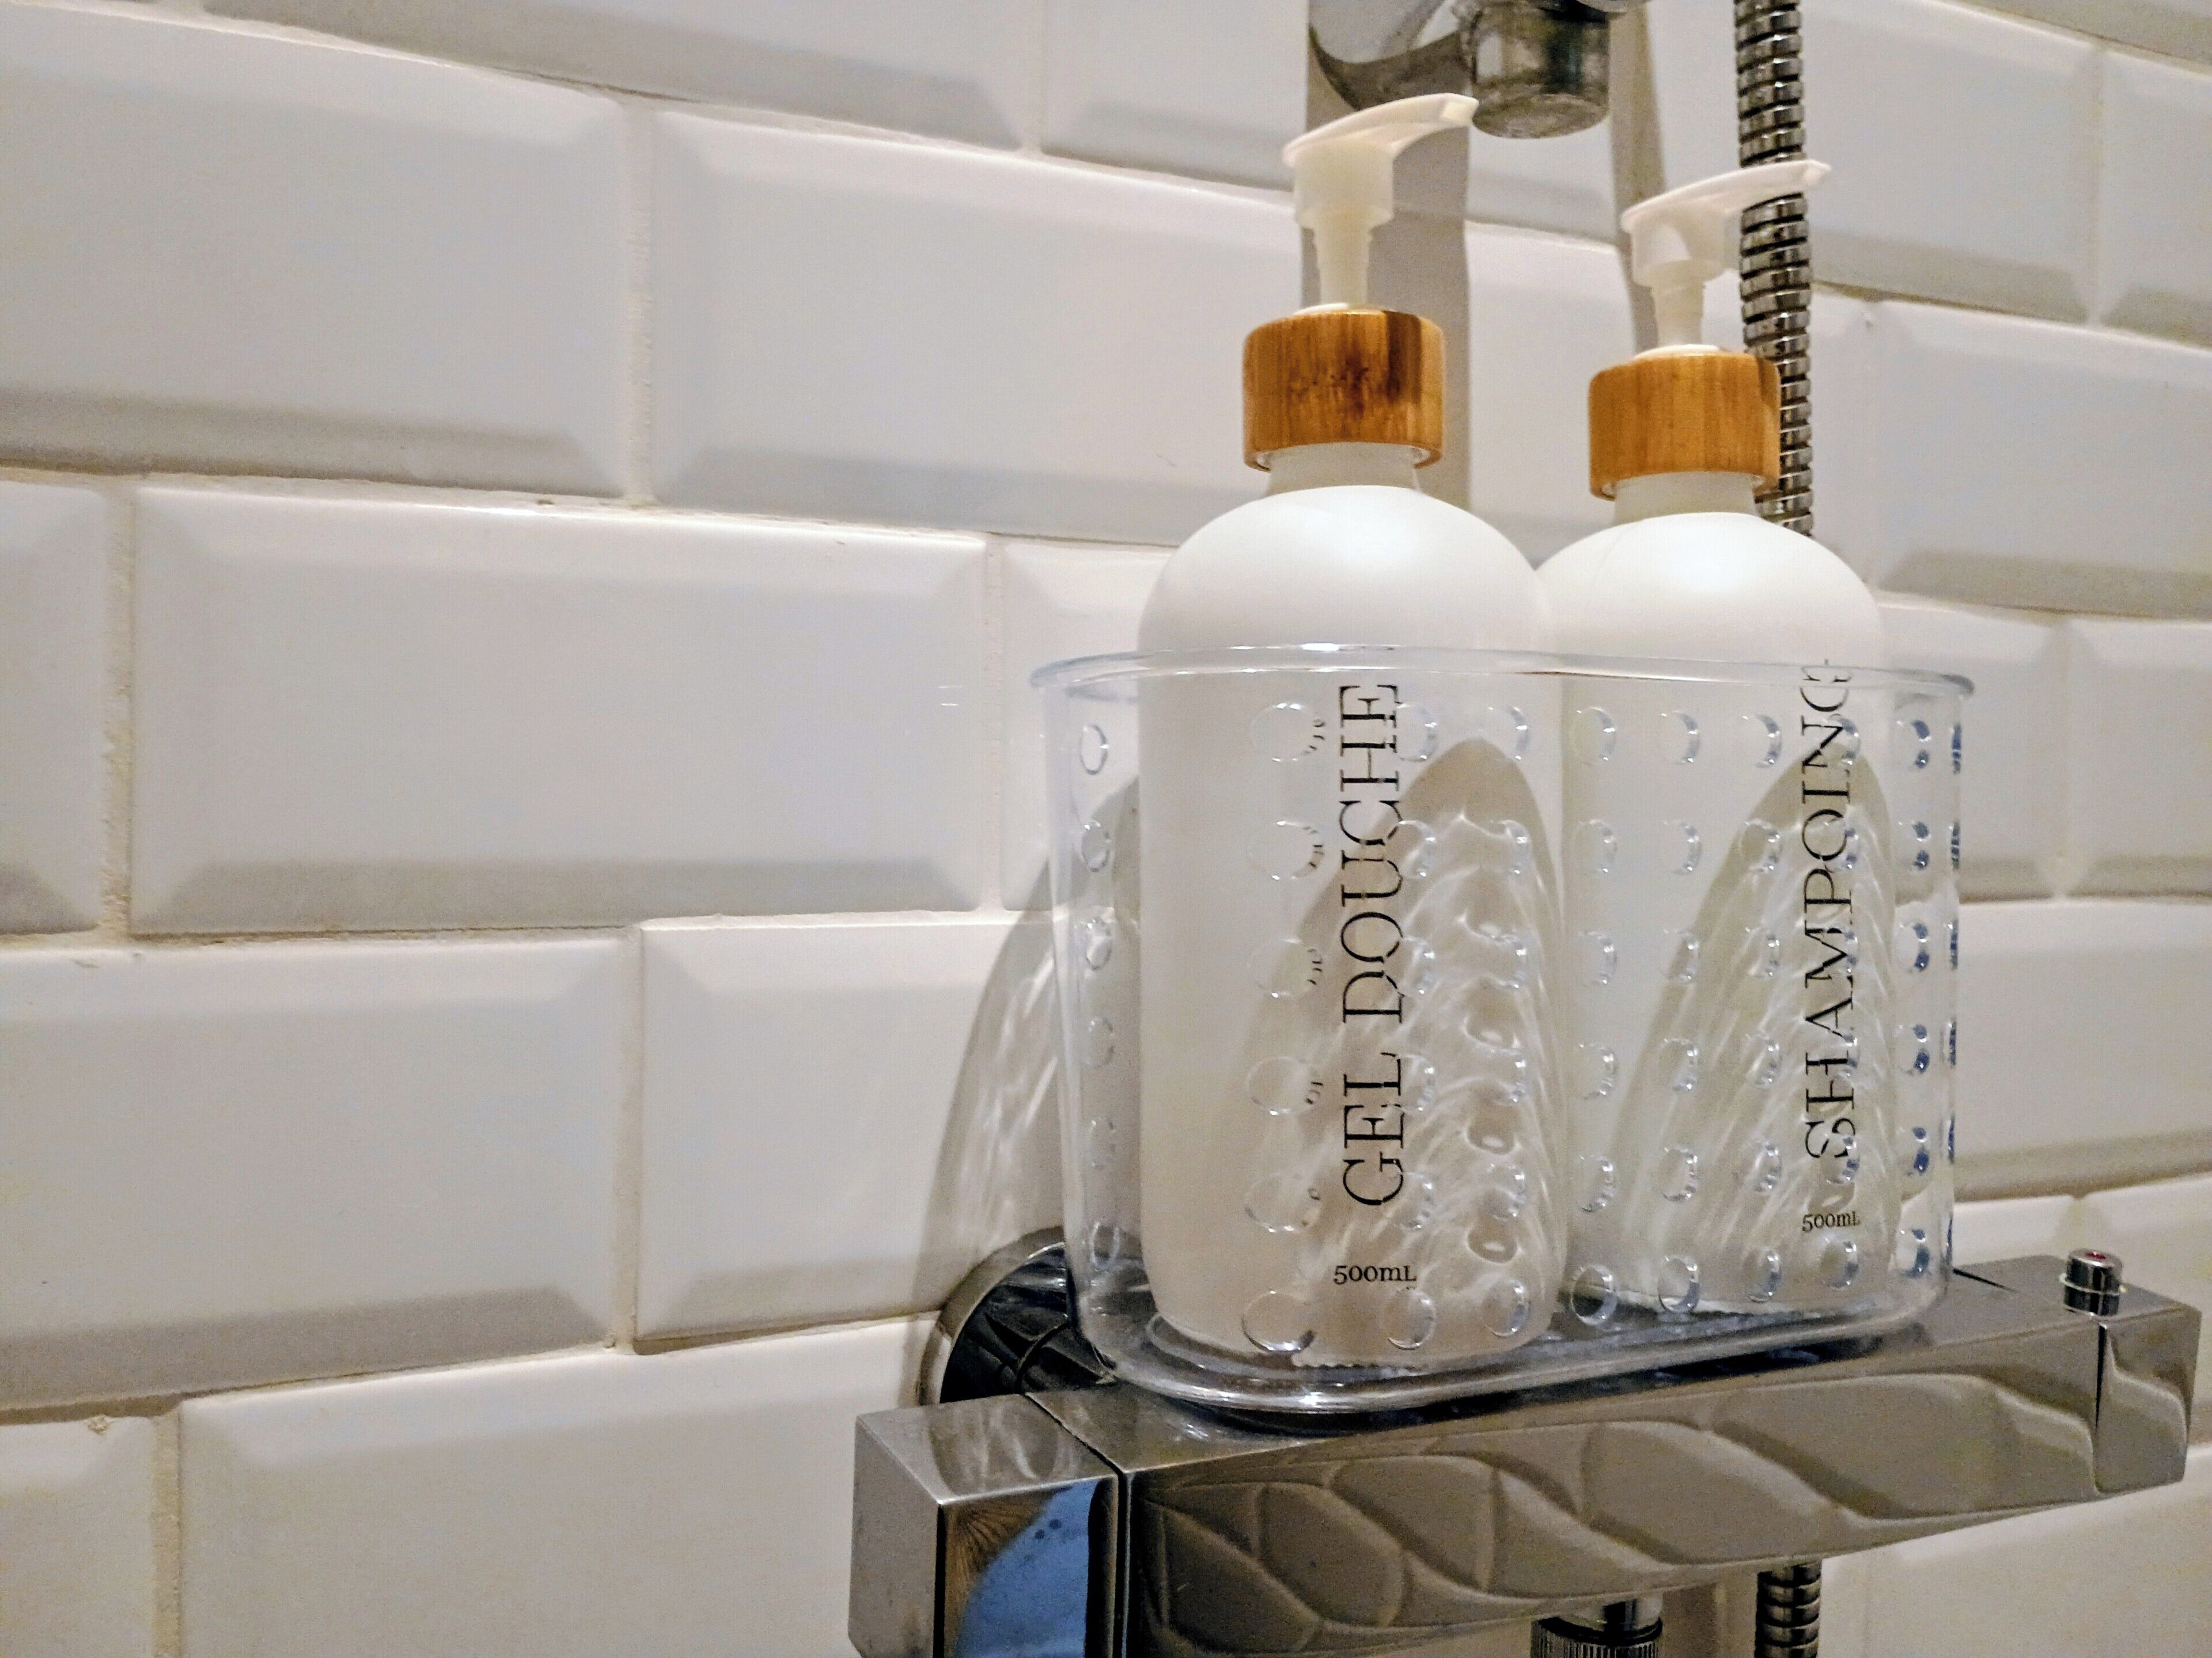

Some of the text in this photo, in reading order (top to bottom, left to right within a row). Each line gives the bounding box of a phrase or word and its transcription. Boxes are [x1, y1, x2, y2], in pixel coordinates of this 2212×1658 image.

[1339, 684, 1405, 1206] GEL DOUCHE
[1801, 1210, 1861, 1232] 500mL
[1333, 1265, 1417, 1285] 500mL
